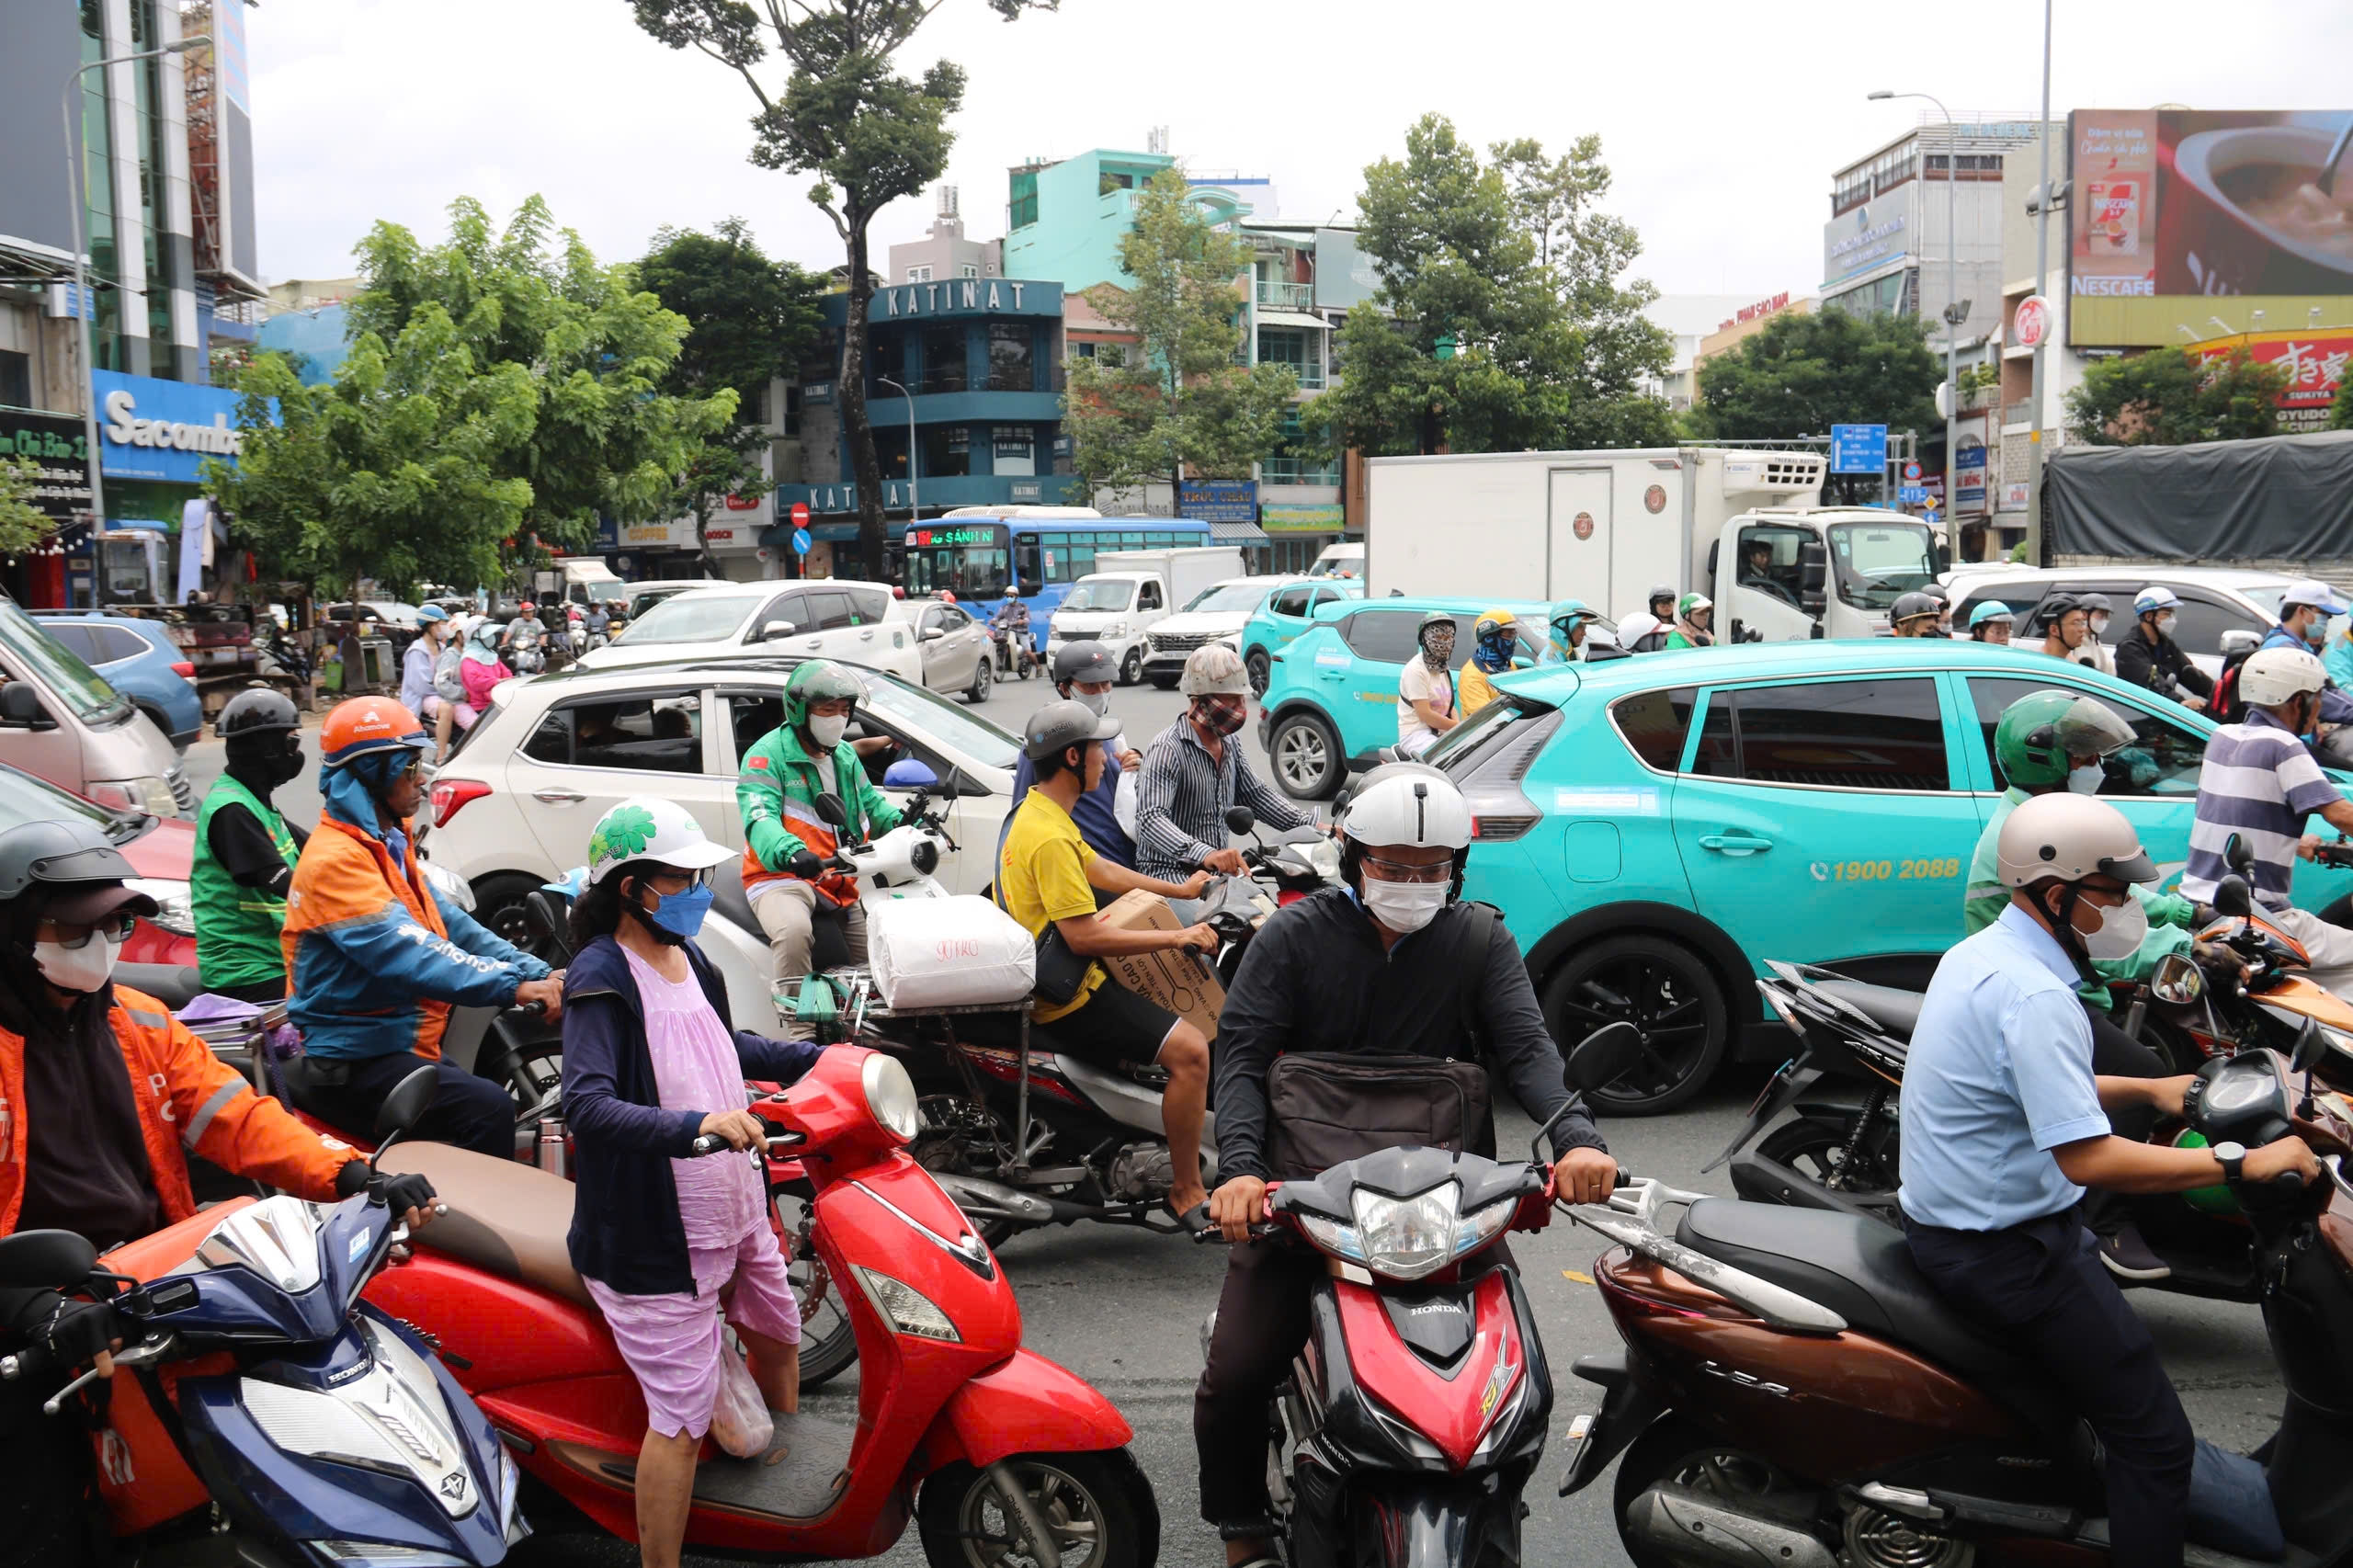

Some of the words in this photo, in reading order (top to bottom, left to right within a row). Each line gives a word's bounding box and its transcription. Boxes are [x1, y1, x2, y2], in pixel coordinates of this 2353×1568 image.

[889, 281, 1024, 316] KATINAT
[2288, 391, 2331, 400] SUKIYA
[106, 390, 244, 456] Sacomba
[2276, 408, 2331, 422] GYUDO
[597, 845, 623, 864] HELMET
[1832, 861, 1892, 880] 1900
[1898, 859, 1961, 879] 2088
[1410, 1304, 1462, 1316] HONDA
